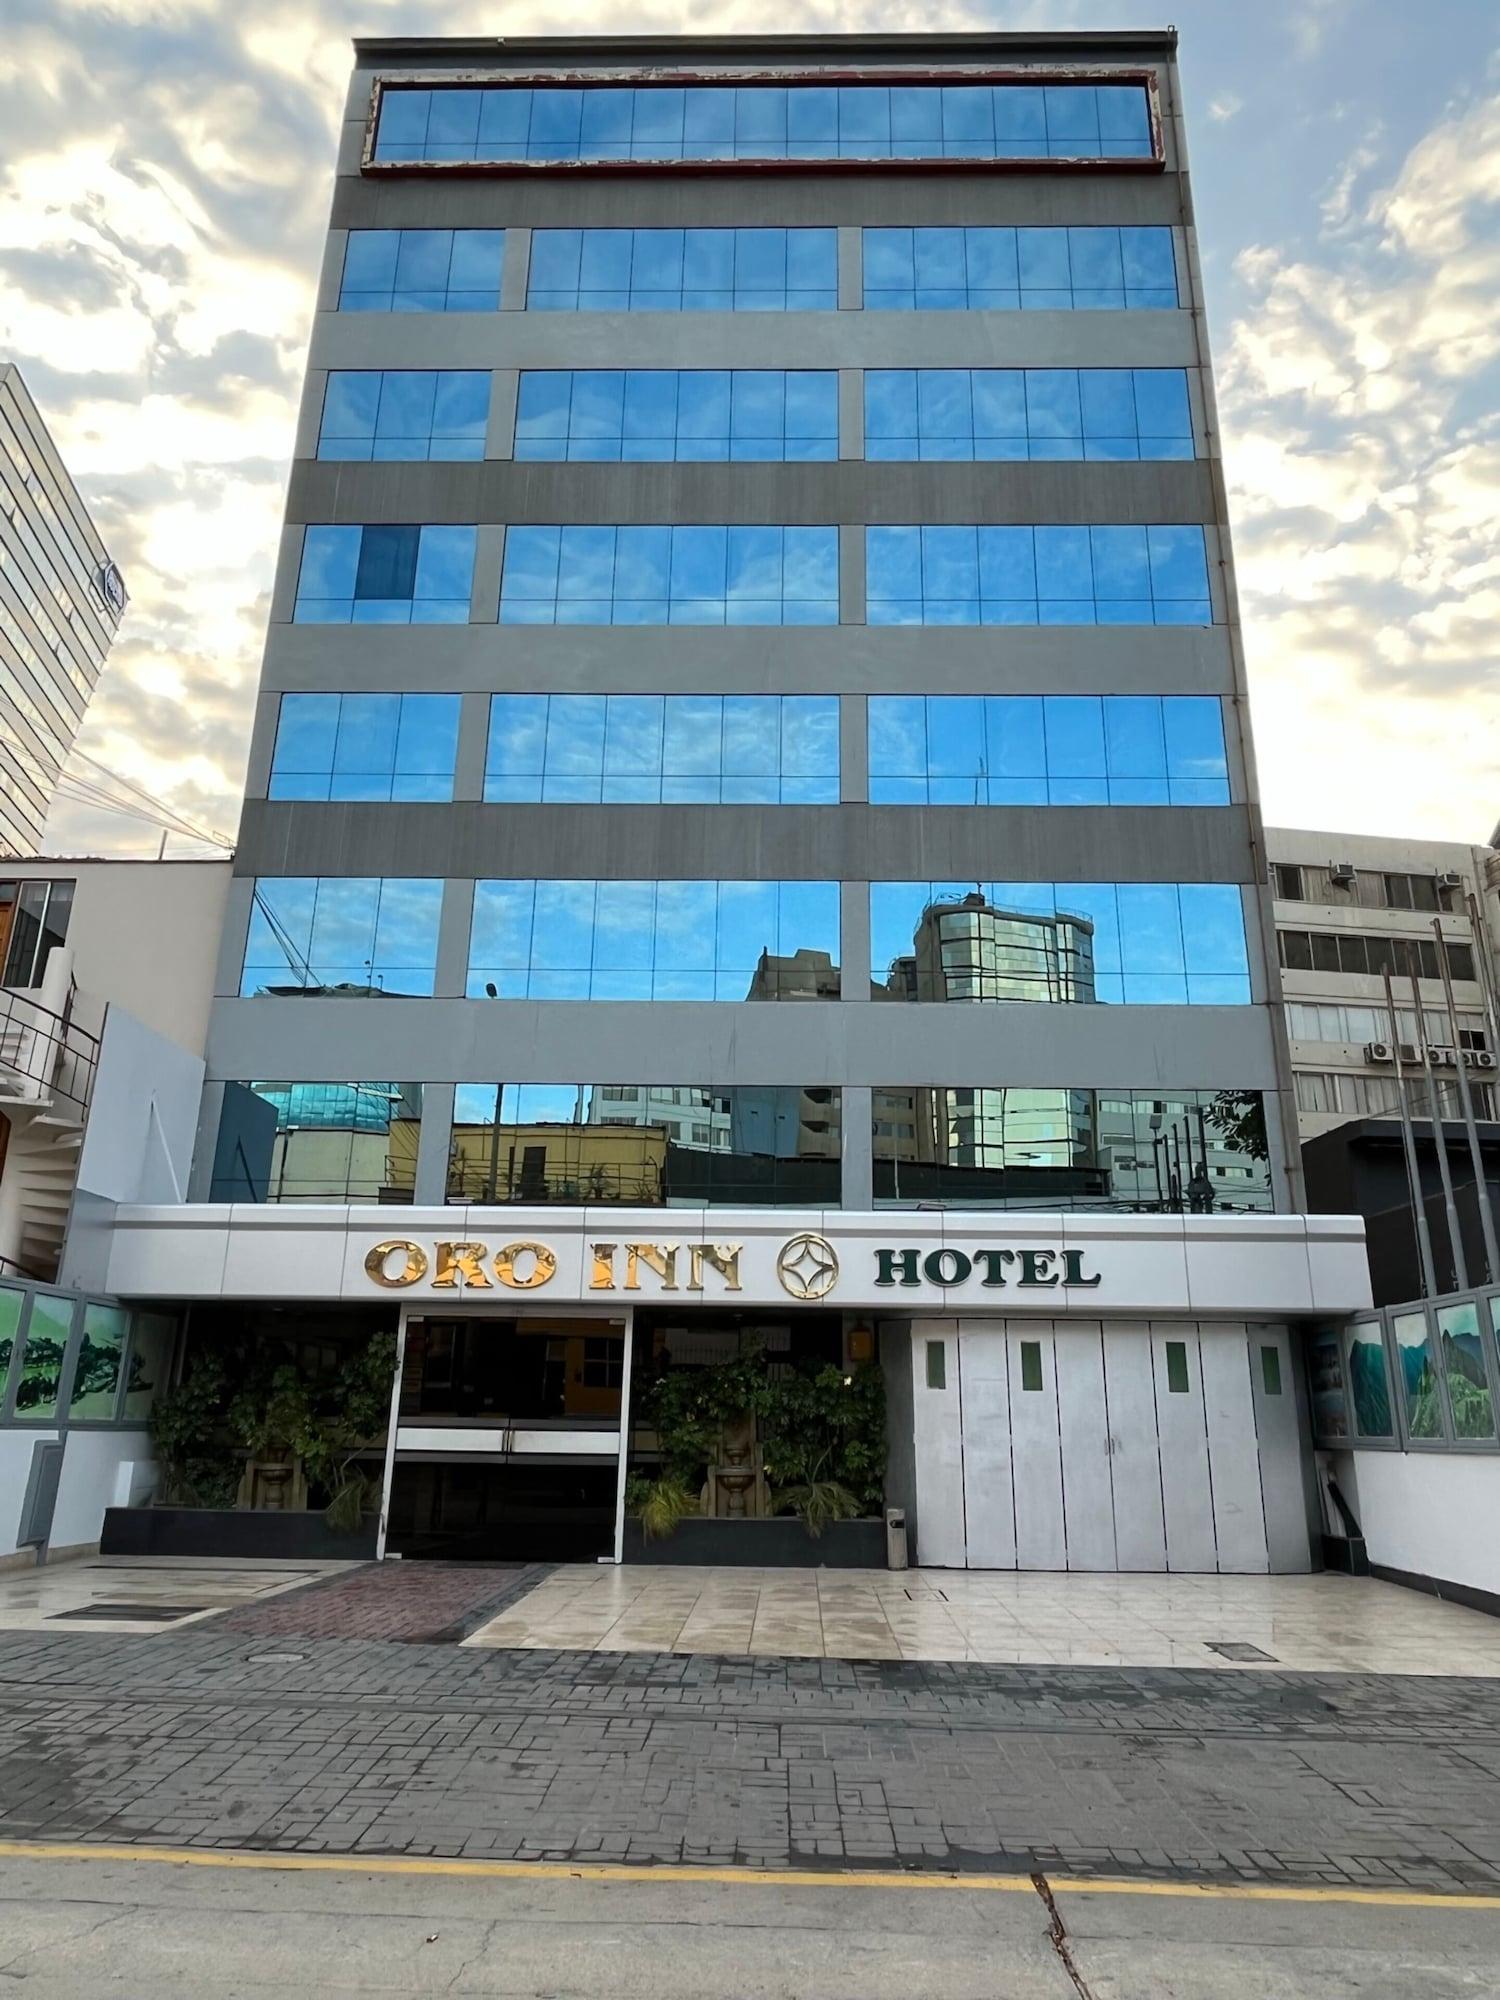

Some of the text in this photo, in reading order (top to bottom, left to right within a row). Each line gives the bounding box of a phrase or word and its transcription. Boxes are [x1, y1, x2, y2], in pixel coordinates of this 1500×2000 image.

[364, 1240, 1102, 1291] ORO INN HOTEL
